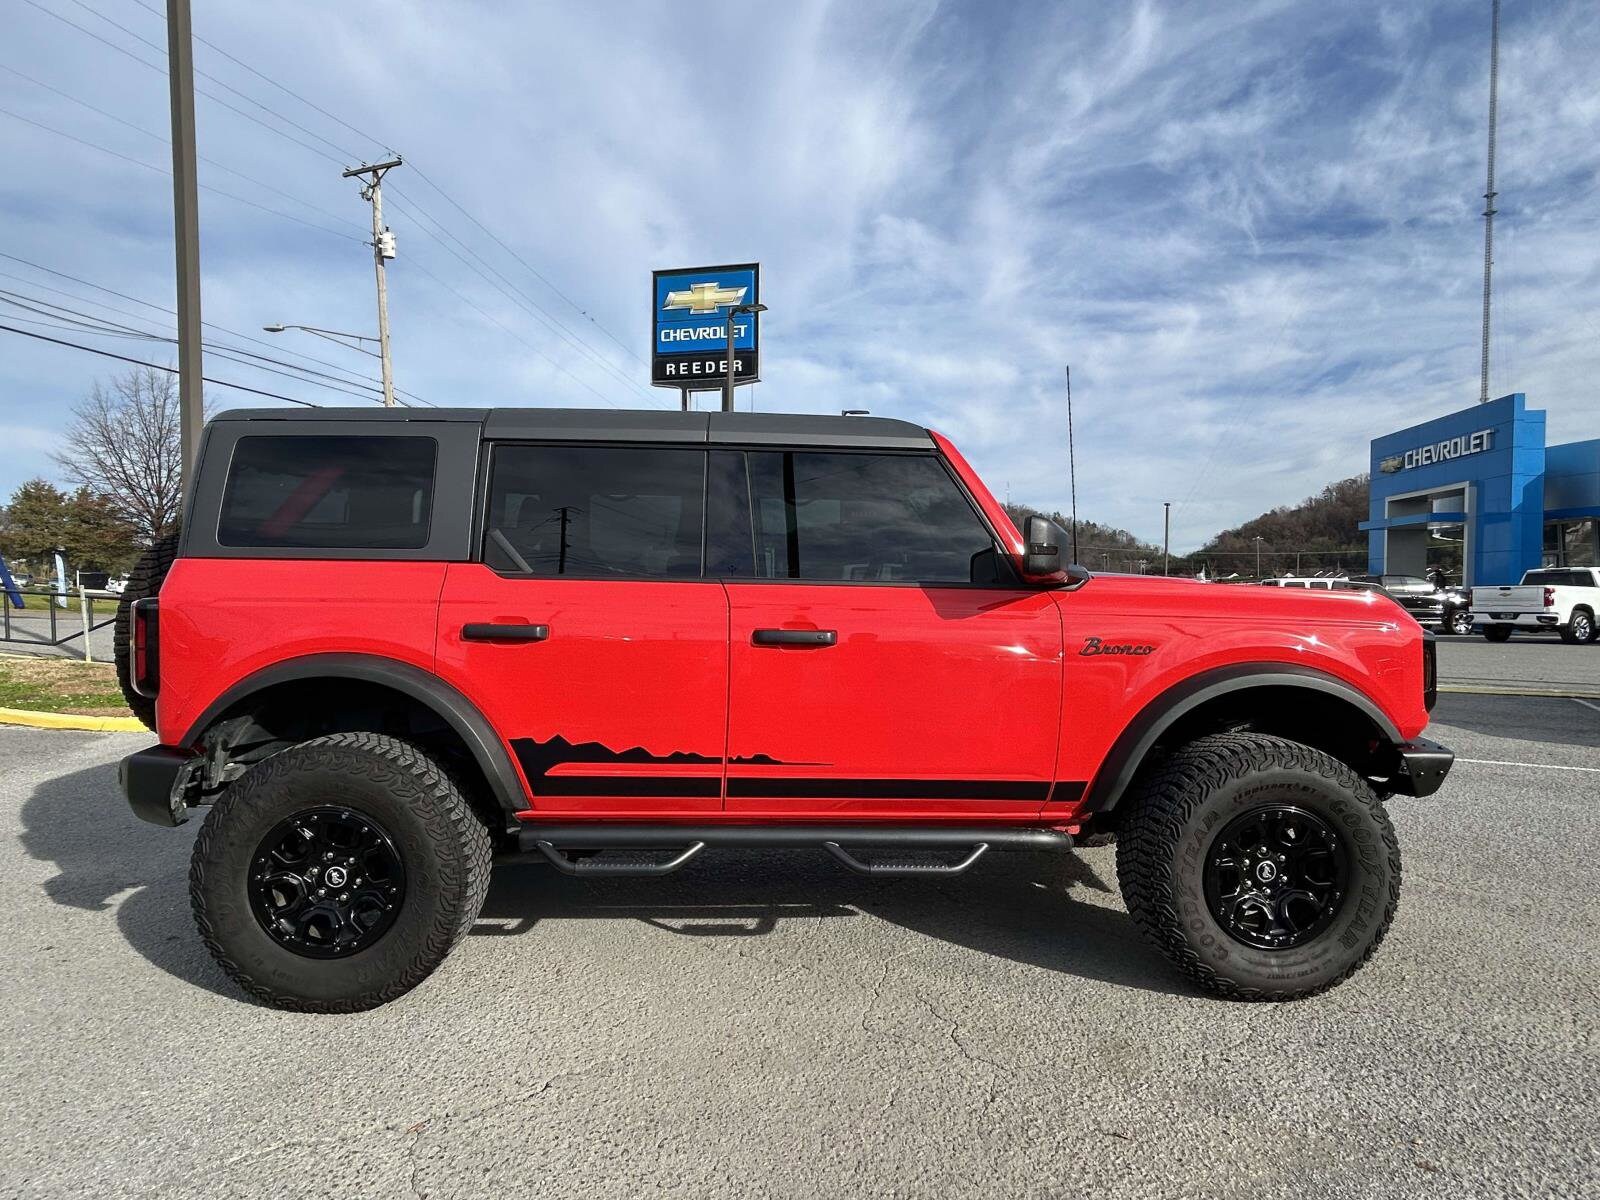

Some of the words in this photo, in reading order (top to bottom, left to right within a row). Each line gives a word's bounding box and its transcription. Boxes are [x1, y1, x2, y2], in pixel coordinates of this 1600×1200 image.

[661, 325, 747, 342] CHEVROLET
[666, 360, 742, 375] REEDER
[1404, 428, 1494, 469] CHEVROLET
[1079, 637, 1157, 656] Bronco
